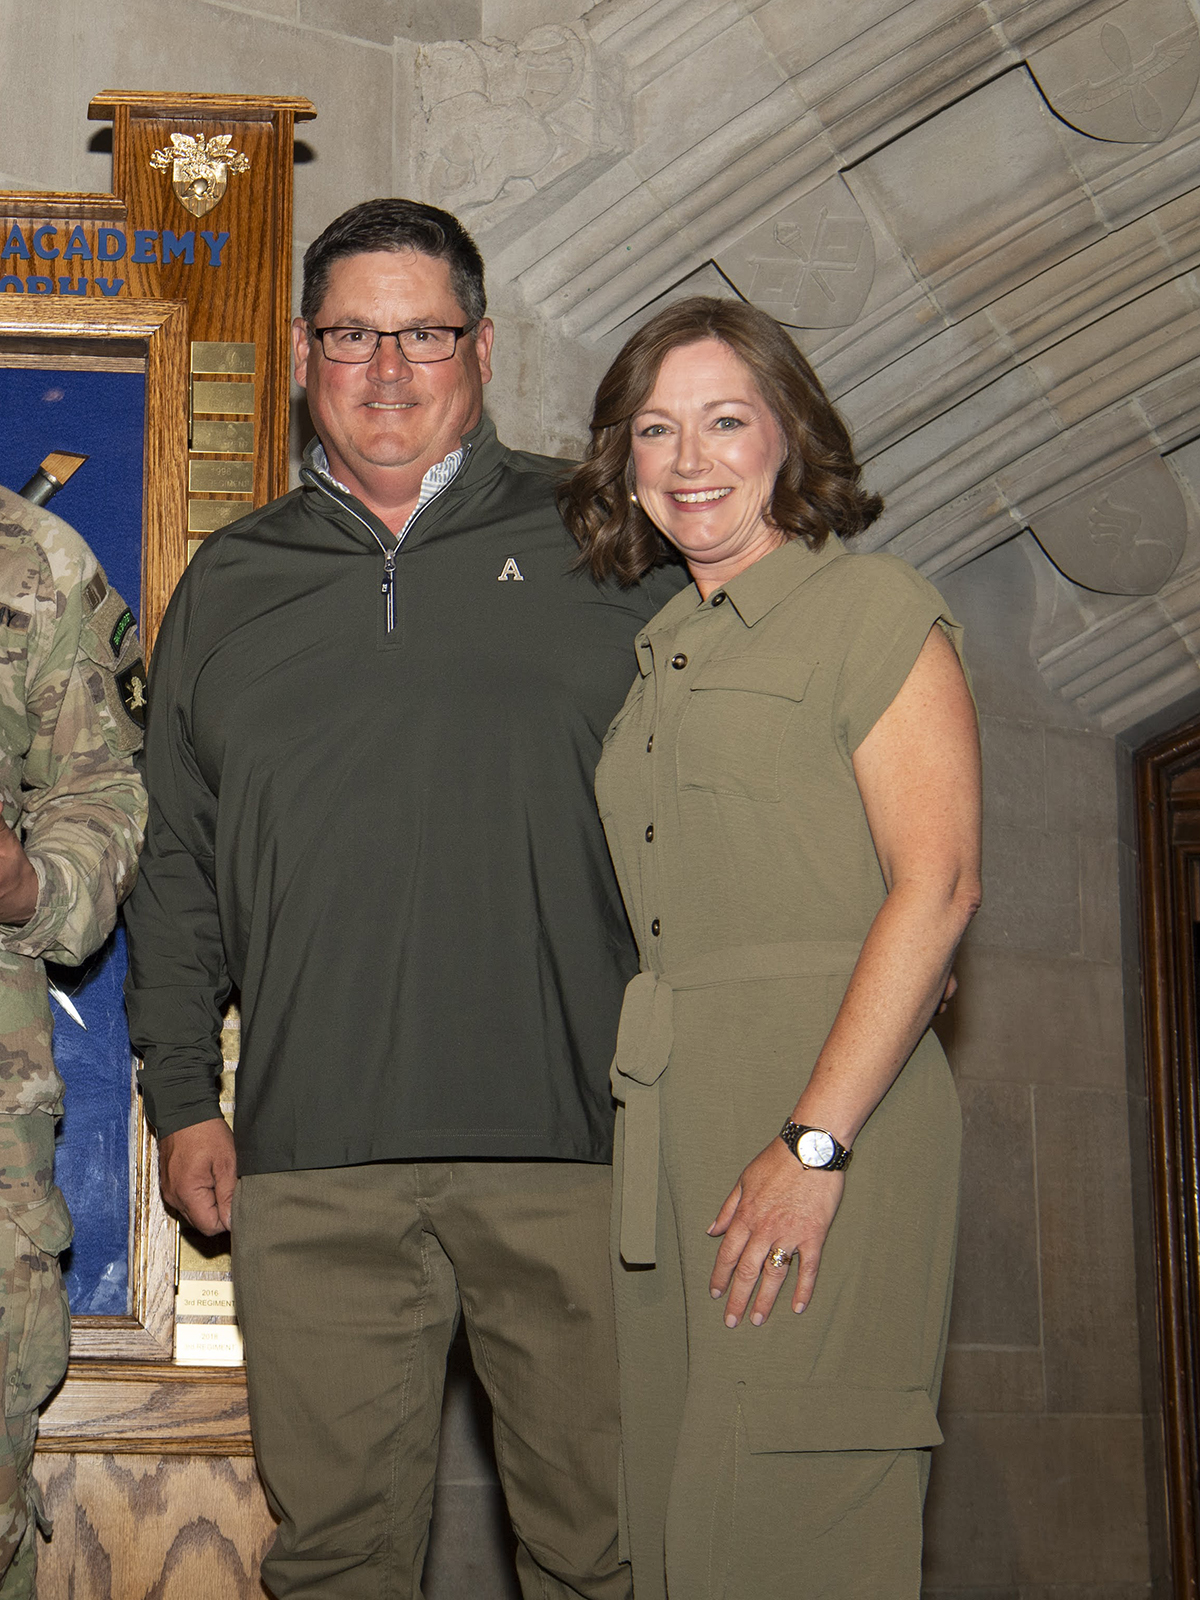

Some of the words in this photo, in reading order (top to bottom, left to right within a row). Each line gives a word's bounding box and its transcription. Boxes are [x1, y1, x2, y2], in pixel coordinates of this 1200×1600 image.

[1, 224, 231, 268] ACADEMY
[497, 557, 524, 581] A
[201, 1289, 219, 1297] 2016
[196, 1299, 236, 1307] REGIMENT
